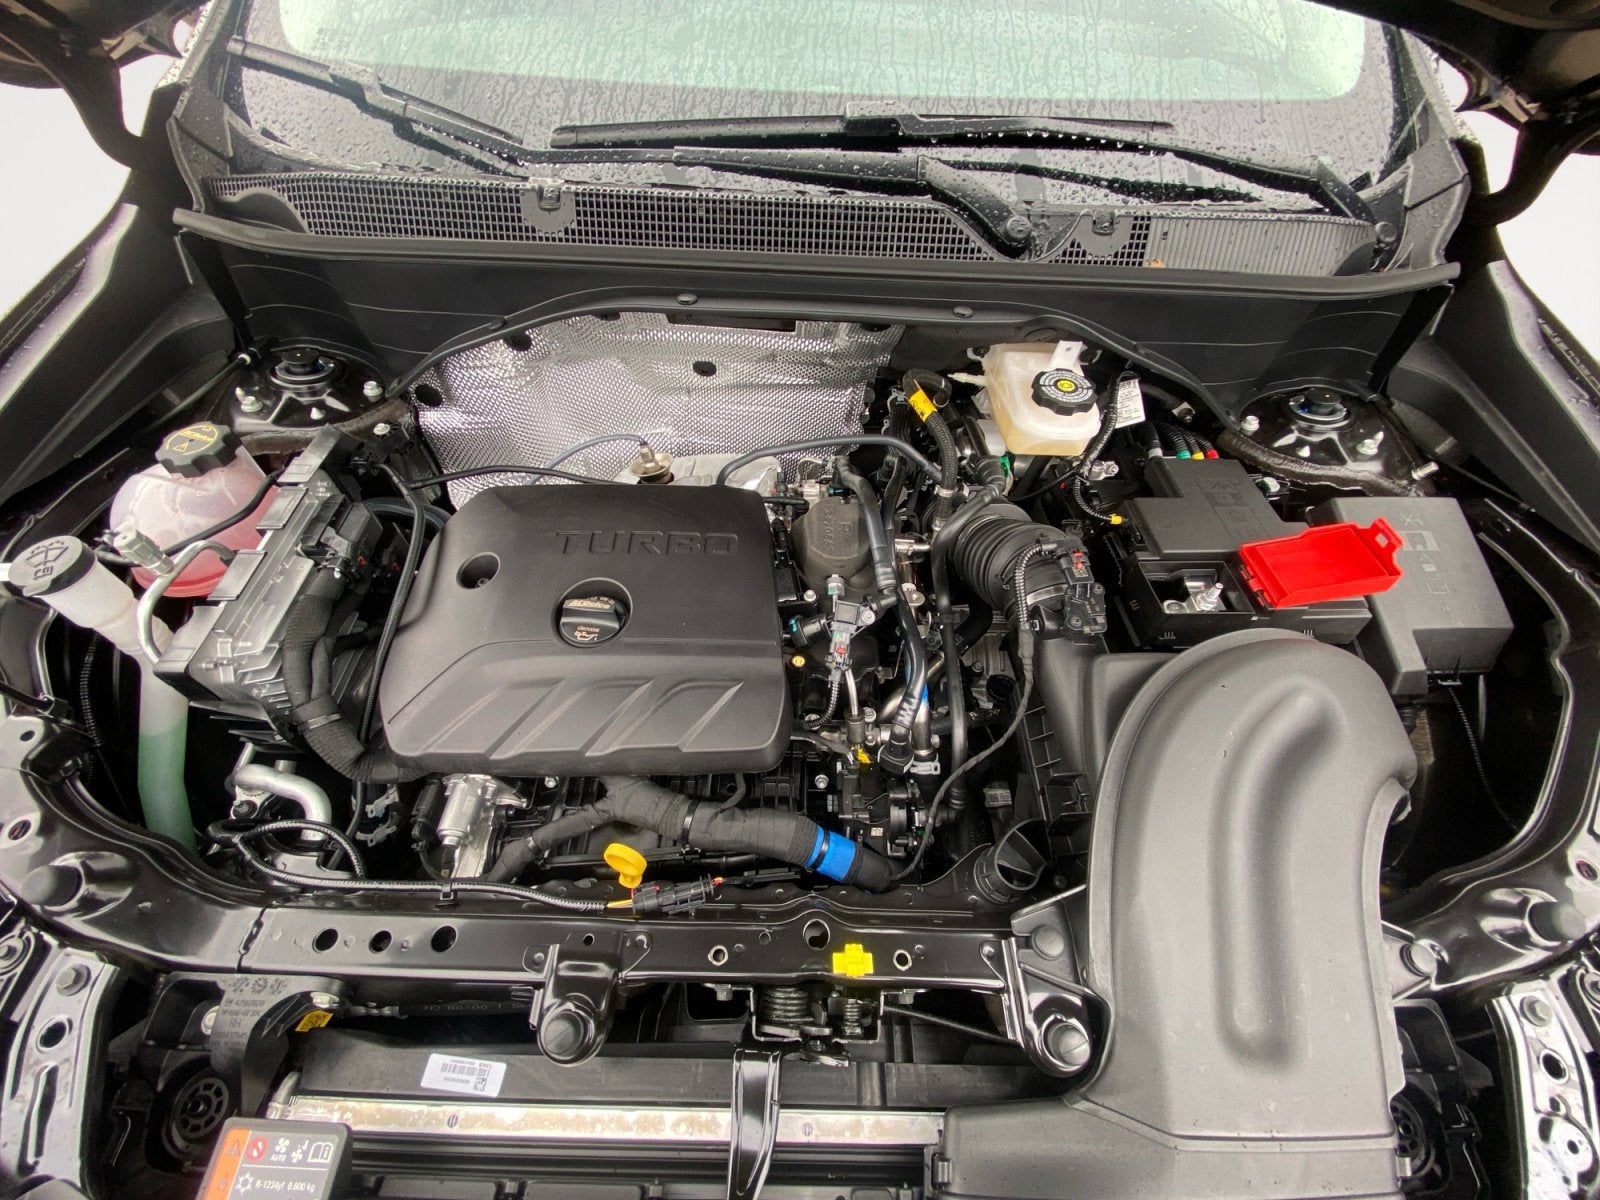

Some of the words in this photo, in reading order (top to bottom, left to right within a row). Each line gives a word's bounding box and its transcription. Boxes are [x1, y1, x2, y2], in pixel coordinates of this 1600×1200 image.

[555, 530, 739, 556] TURBO
[568, 599, 611, 609] ACDelco
[255, 1178, 285, 1191] R-1234yf
[307, 1183, 316, 1193] kg
